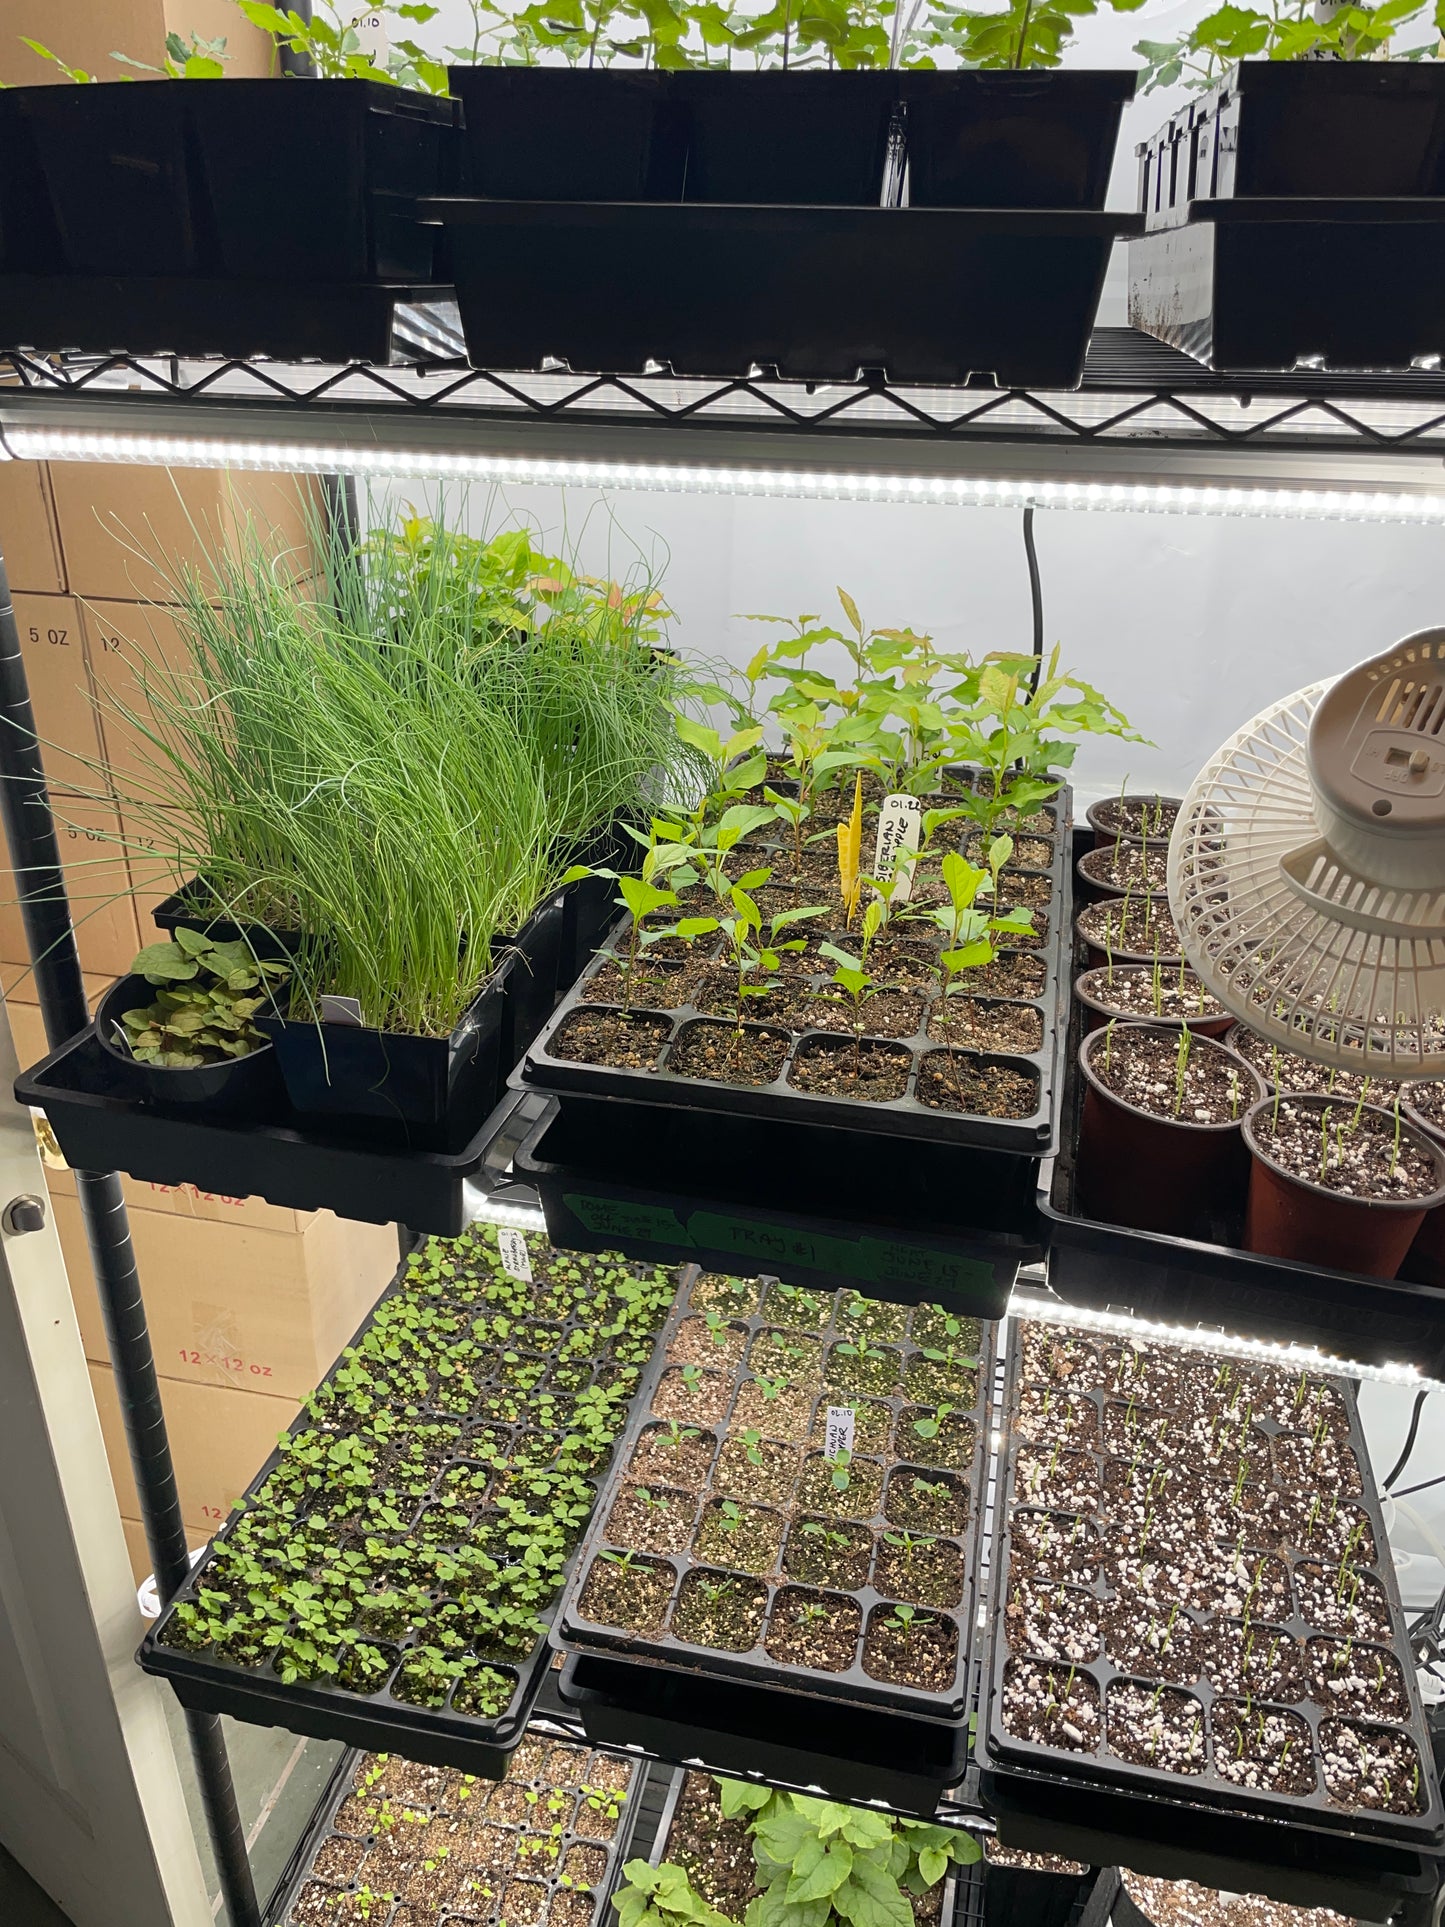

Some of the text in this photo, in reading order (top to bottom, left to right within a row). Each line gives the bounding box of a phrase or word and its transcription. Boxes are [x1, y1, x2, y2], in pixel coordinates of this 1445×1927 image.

[29, 627, 70, 646] 5 OZ
[101, 637, 121, 653] 12
[792, 1241, 816, 1263] #1
[249, 1364, 273, 1377] oz
